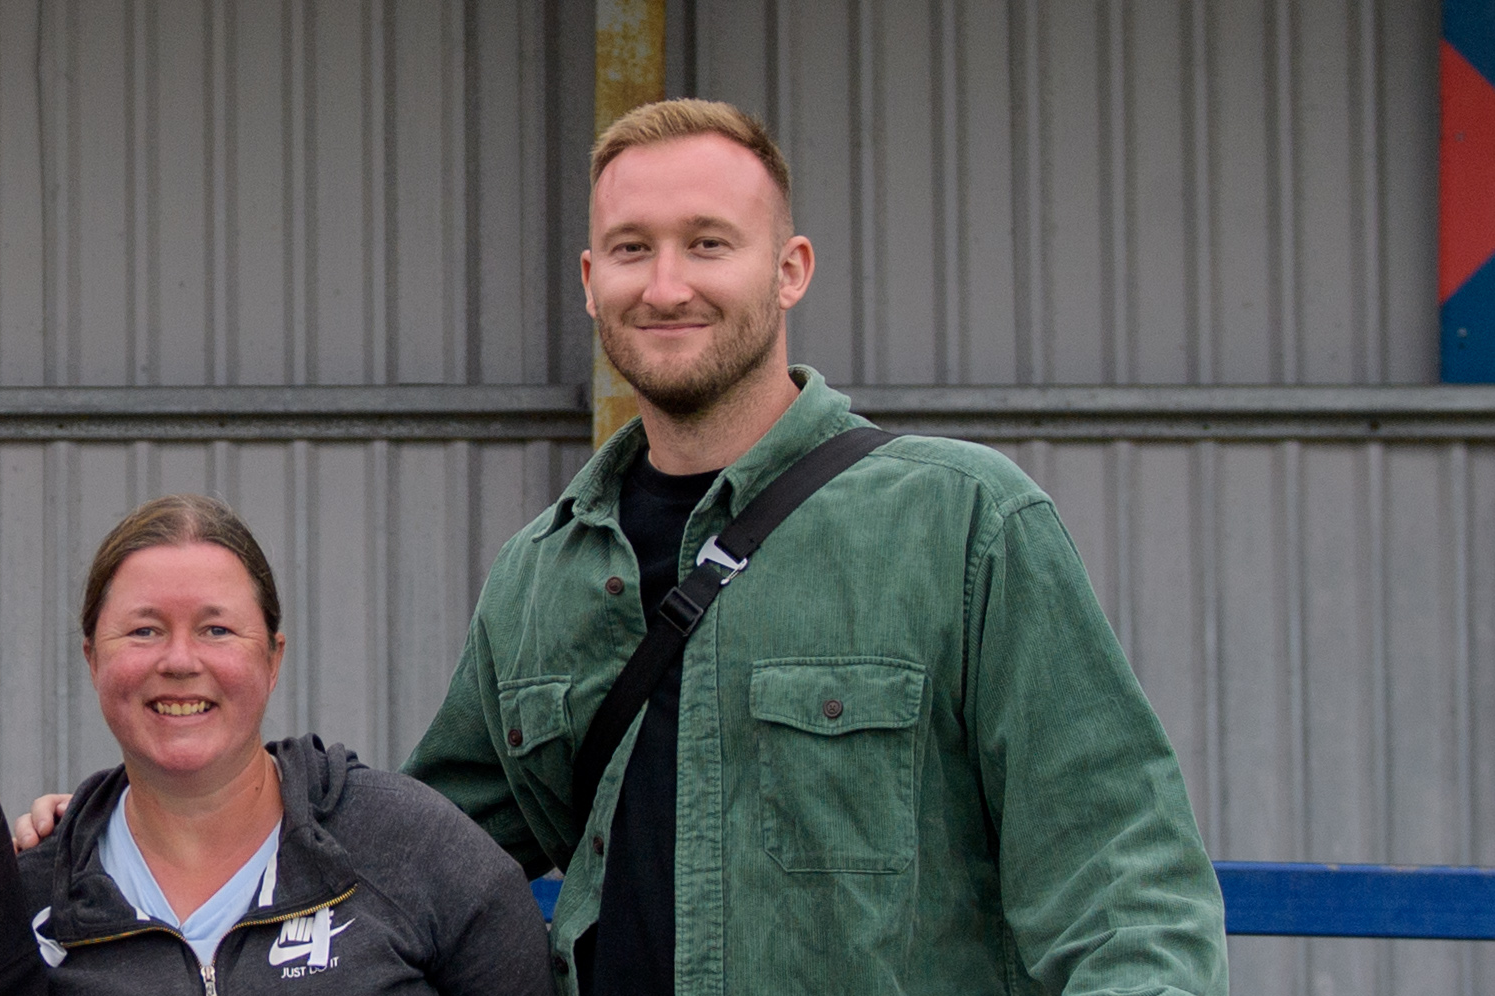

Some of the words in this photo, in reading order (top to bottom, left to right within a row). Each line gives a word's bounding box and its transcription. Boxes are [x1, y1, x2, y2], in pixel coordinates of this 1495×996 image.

[278, 909, 334, 944] NI
[280, 966, 306, 979] JUST
[329, 956, 340, 968] IT
